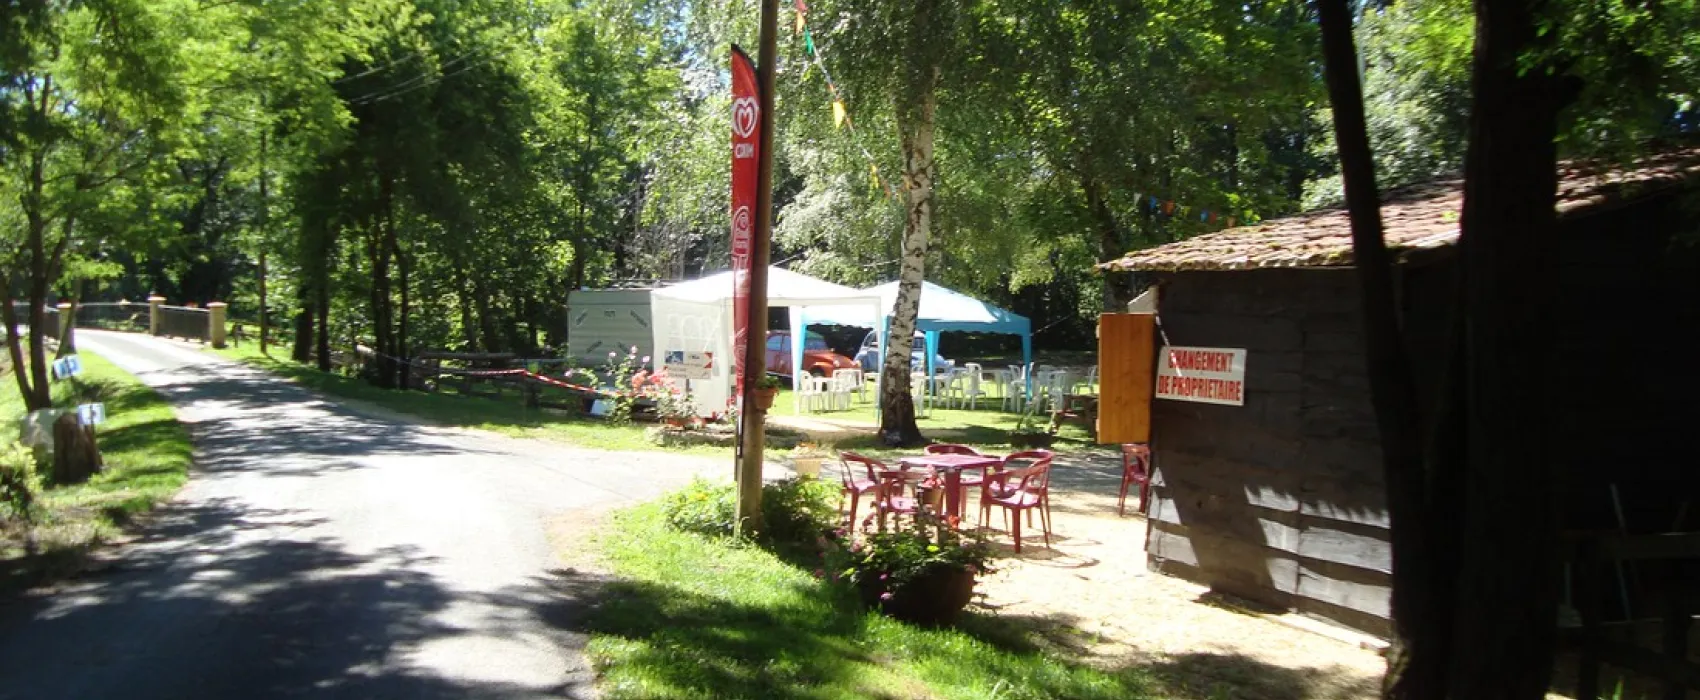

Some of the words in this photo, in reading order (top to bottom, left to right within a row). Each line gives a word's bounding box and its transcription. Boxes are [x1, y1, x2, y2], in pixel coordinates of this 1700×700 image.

[1168, 349, 1235, 372] CHANGEMENT
[1158, 375, 1170, 394] DE
[1172, 375, 1242, 401] PROPRIETAIRE
